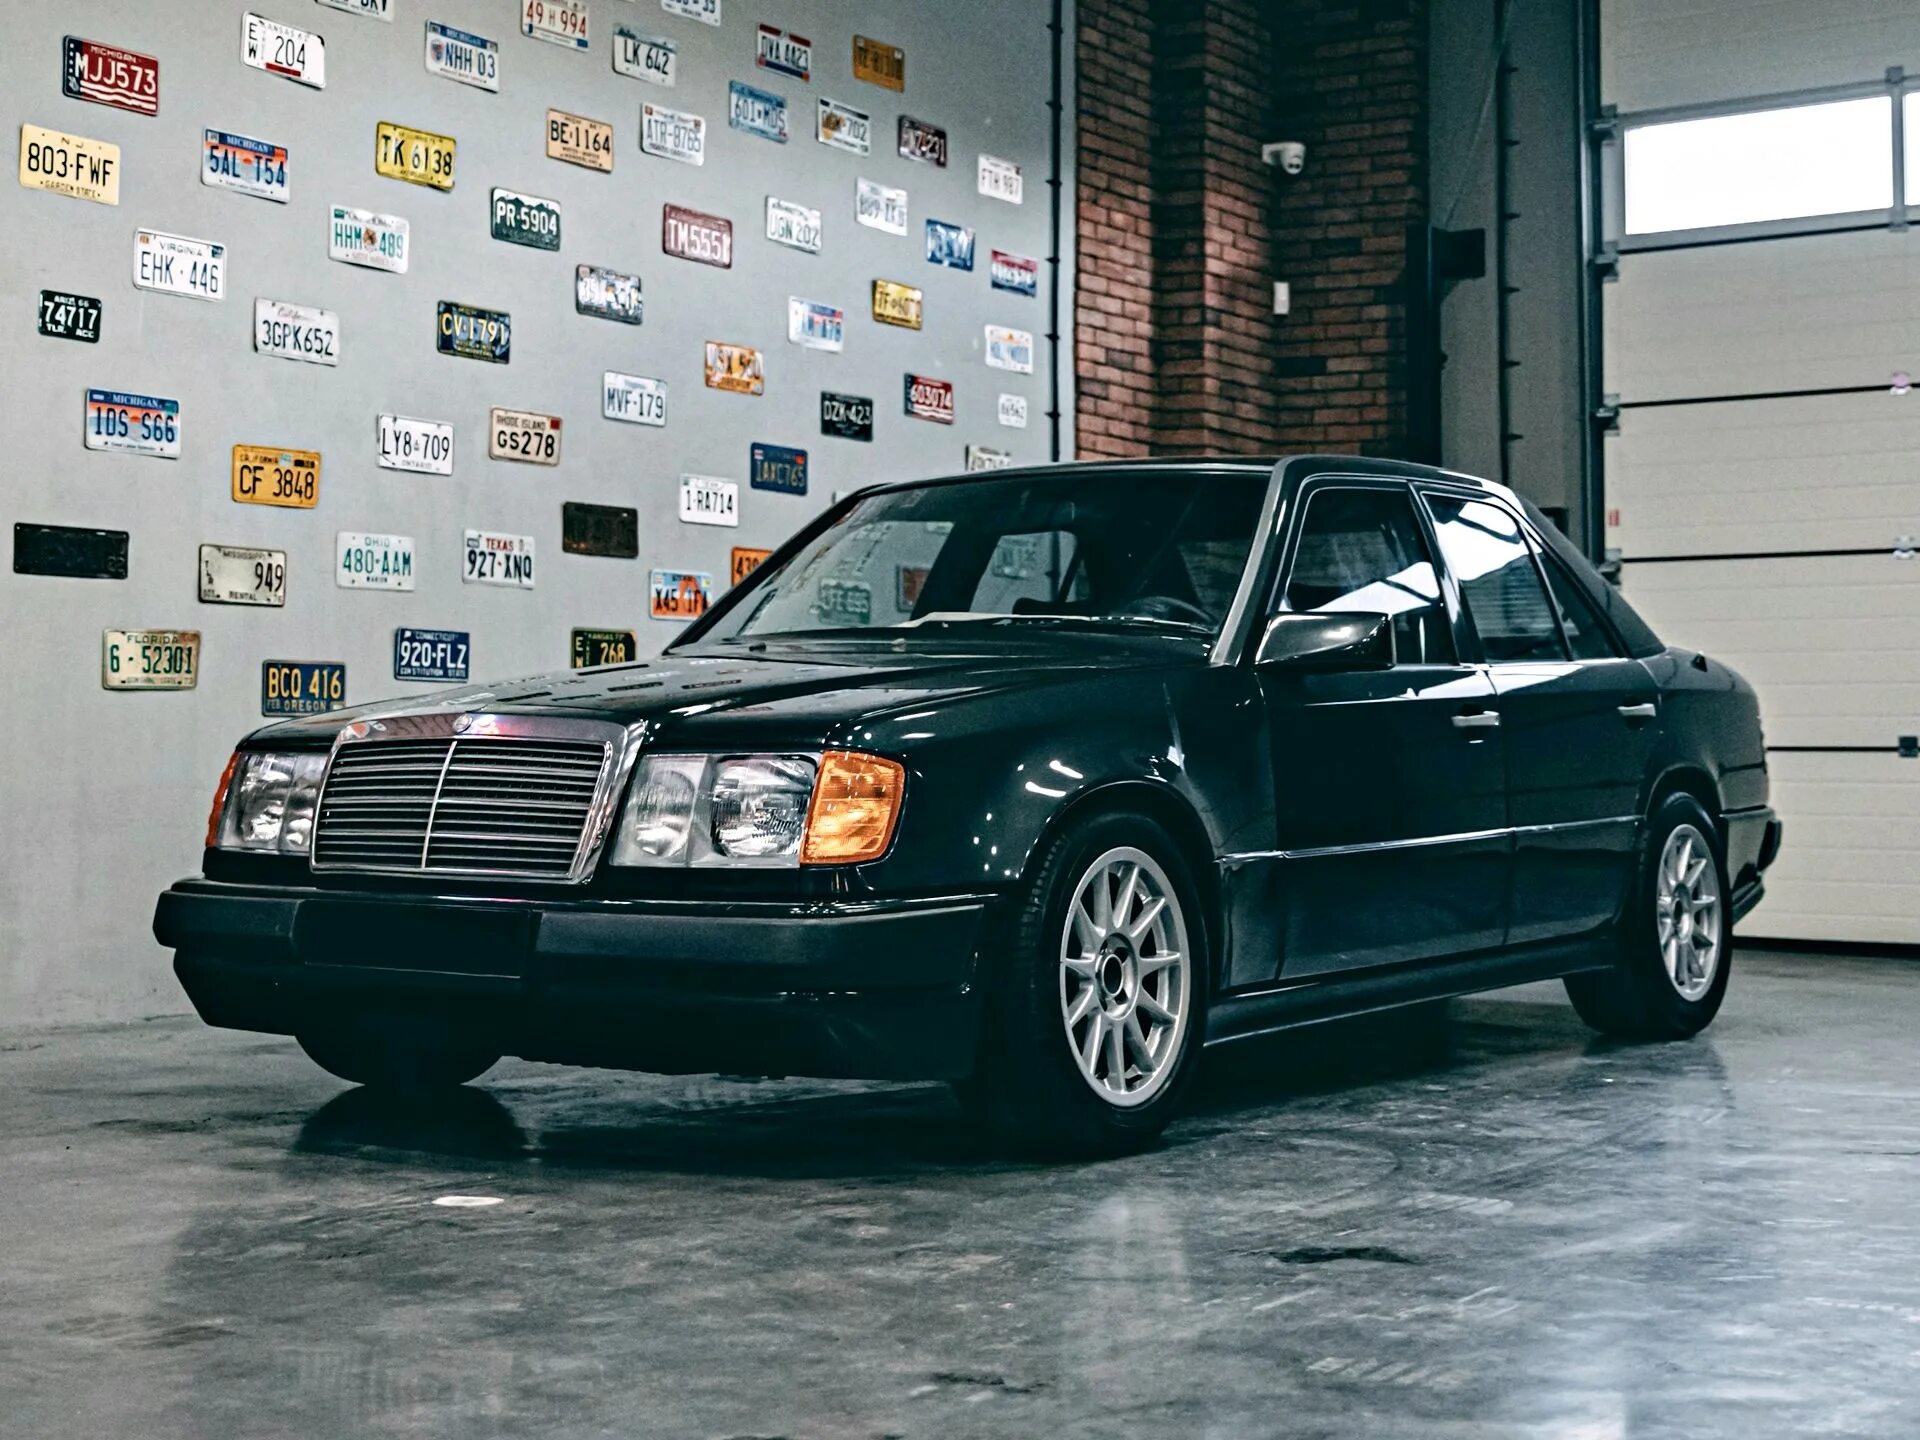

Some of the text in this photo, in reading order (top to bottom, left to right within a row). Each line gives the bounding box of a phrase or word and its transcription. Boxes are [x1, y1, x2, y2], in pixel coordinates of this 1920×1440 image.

[560, 10, 586, 38] 994
[91, 46, 137, 63] MICHIGAN
[274, 35, 306, 71] 204
[444, 43, 473, 73] NHH
[478, 52, 496, 79] 03
[624, 38, 670, 76] LK 642
[74, 52, 157, 95] MJJ573
[209, 146, 241, 178] 5AL
[254, 155, 285, 188] T54
[381, 134, 405, 167] TK
[411, 144, 453, 176] 6138
[160, 242, 203, 257] VIRGINIA
[335, 222, 363, 251] HHM
[43, 301, 98, 330] 74717
[262, 320, 334, 356] 3GPK652
[112, 393, 159, 409] MICHIGAN
[95, 407, 176, 443] 1DS S66
[497, 415, 546, 431] RHODE ISLAND
[381, 427, 450, 462] LY8 709
[497, 430, 555, 458] GS278
[401, 459, 432, 469] ONTARIO
[239, 464, 315, 500] CF 3848
[364, 536, 391, 548] OHIO
[486, 538, 515, 552] TEXAS
[255, 561, 284, 593] 949
[229, 591, 258, 602] RENTAL
[126, 635, 178, 645] FLORIDA
[142, 646, 193, 674] 52301
[308, 668, 342, 700] 416
[284, 699, 327, 713] OREGON
